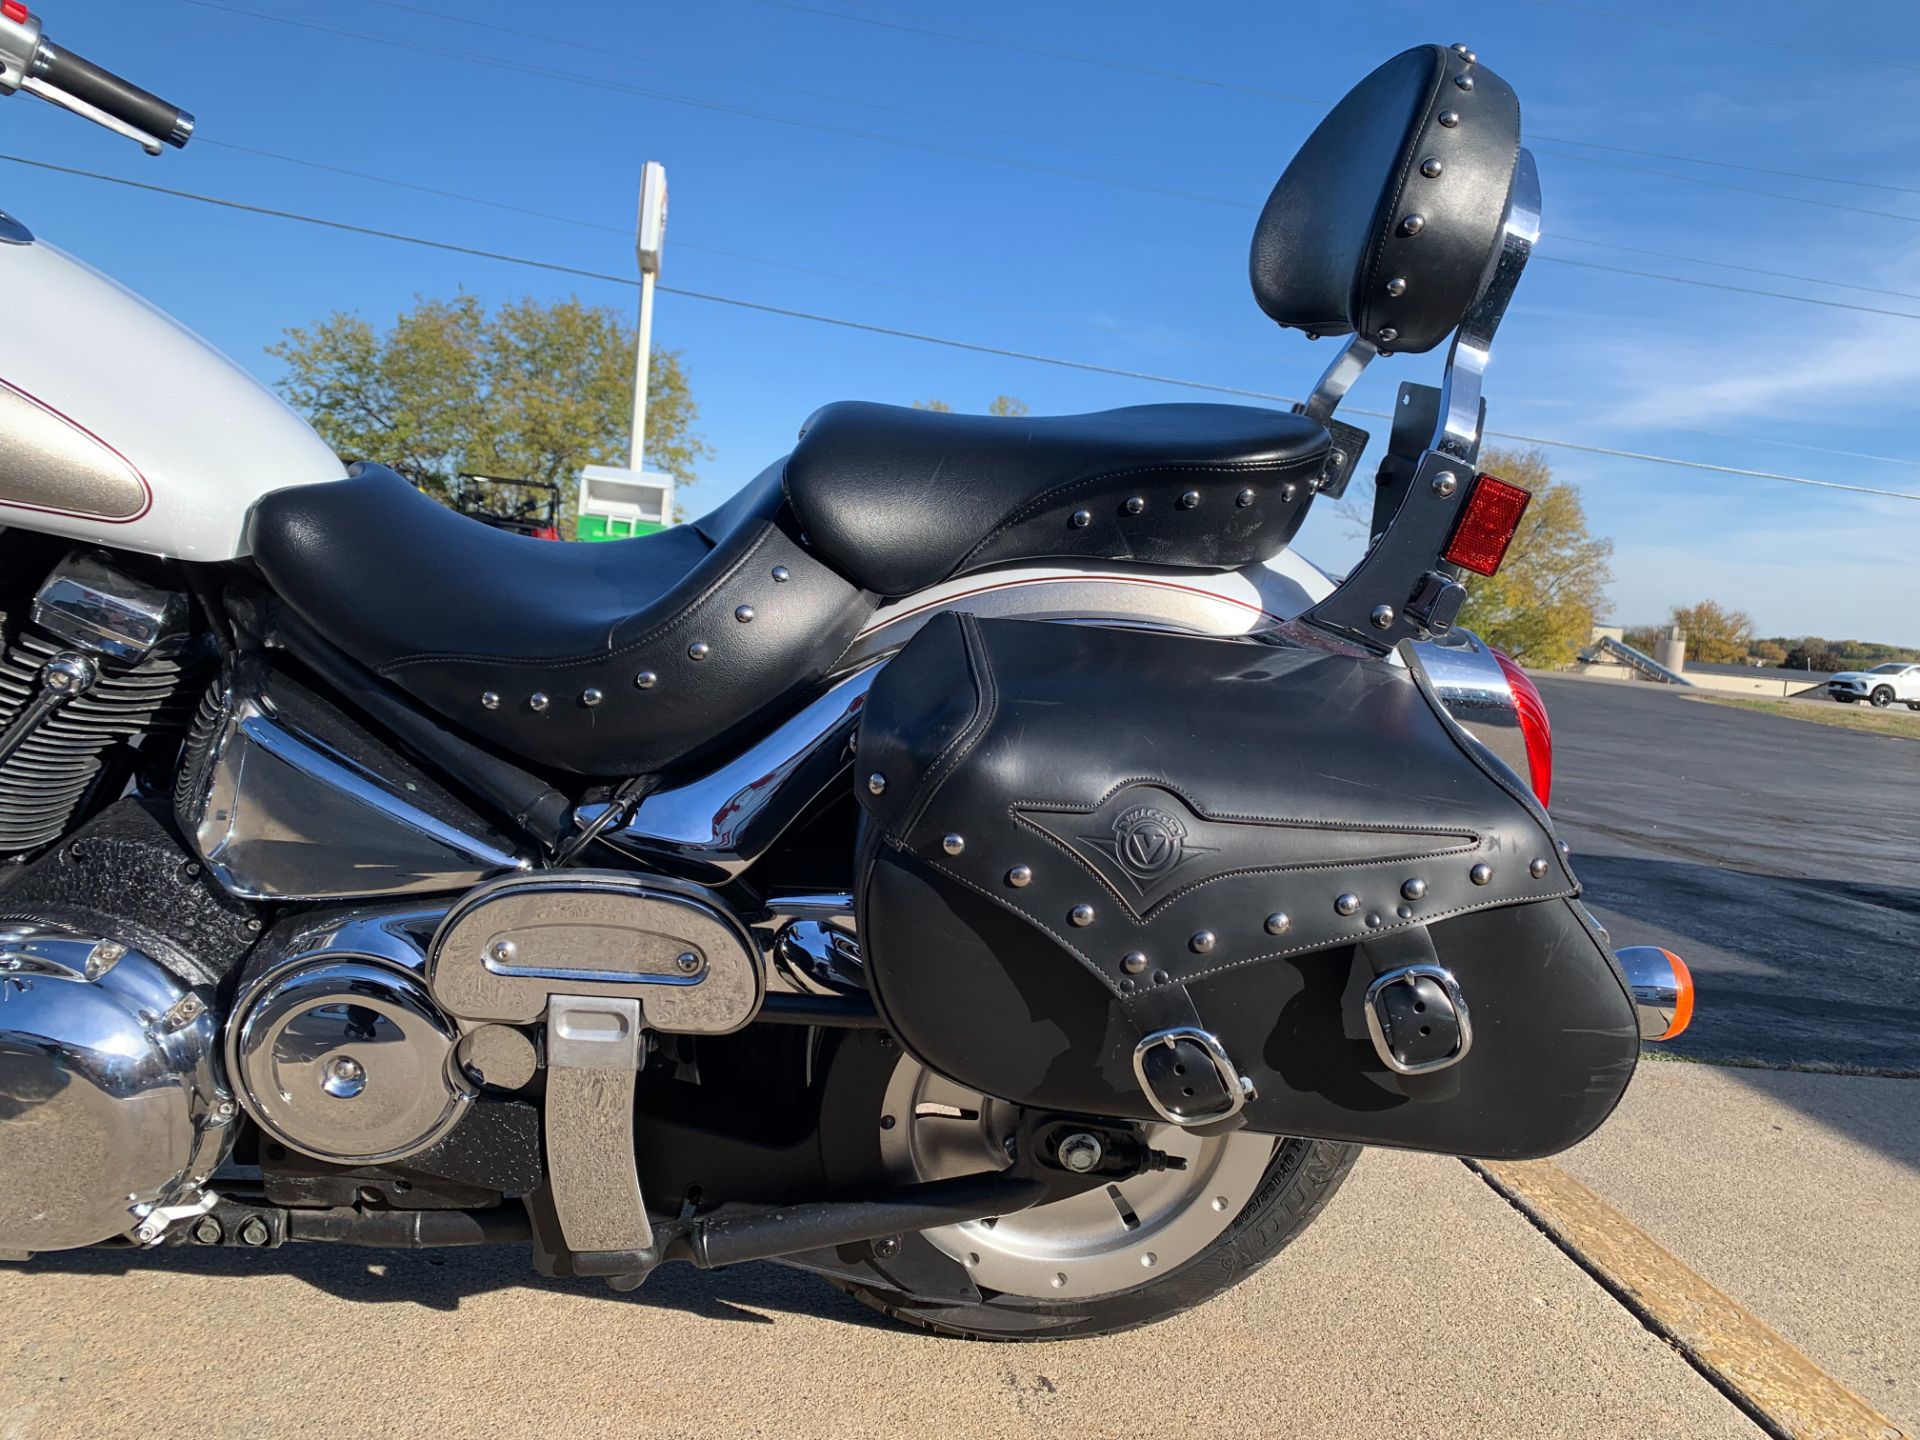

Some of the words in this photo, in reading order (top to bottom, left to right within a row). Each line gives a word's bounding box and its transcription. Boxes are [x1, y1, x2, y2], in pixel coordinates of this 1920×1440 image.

[1119, 808, 1182, 836] VULCAN
[1132, 832, 1167, 865] V
[1255, 1139, 1342, 1248] DUN
